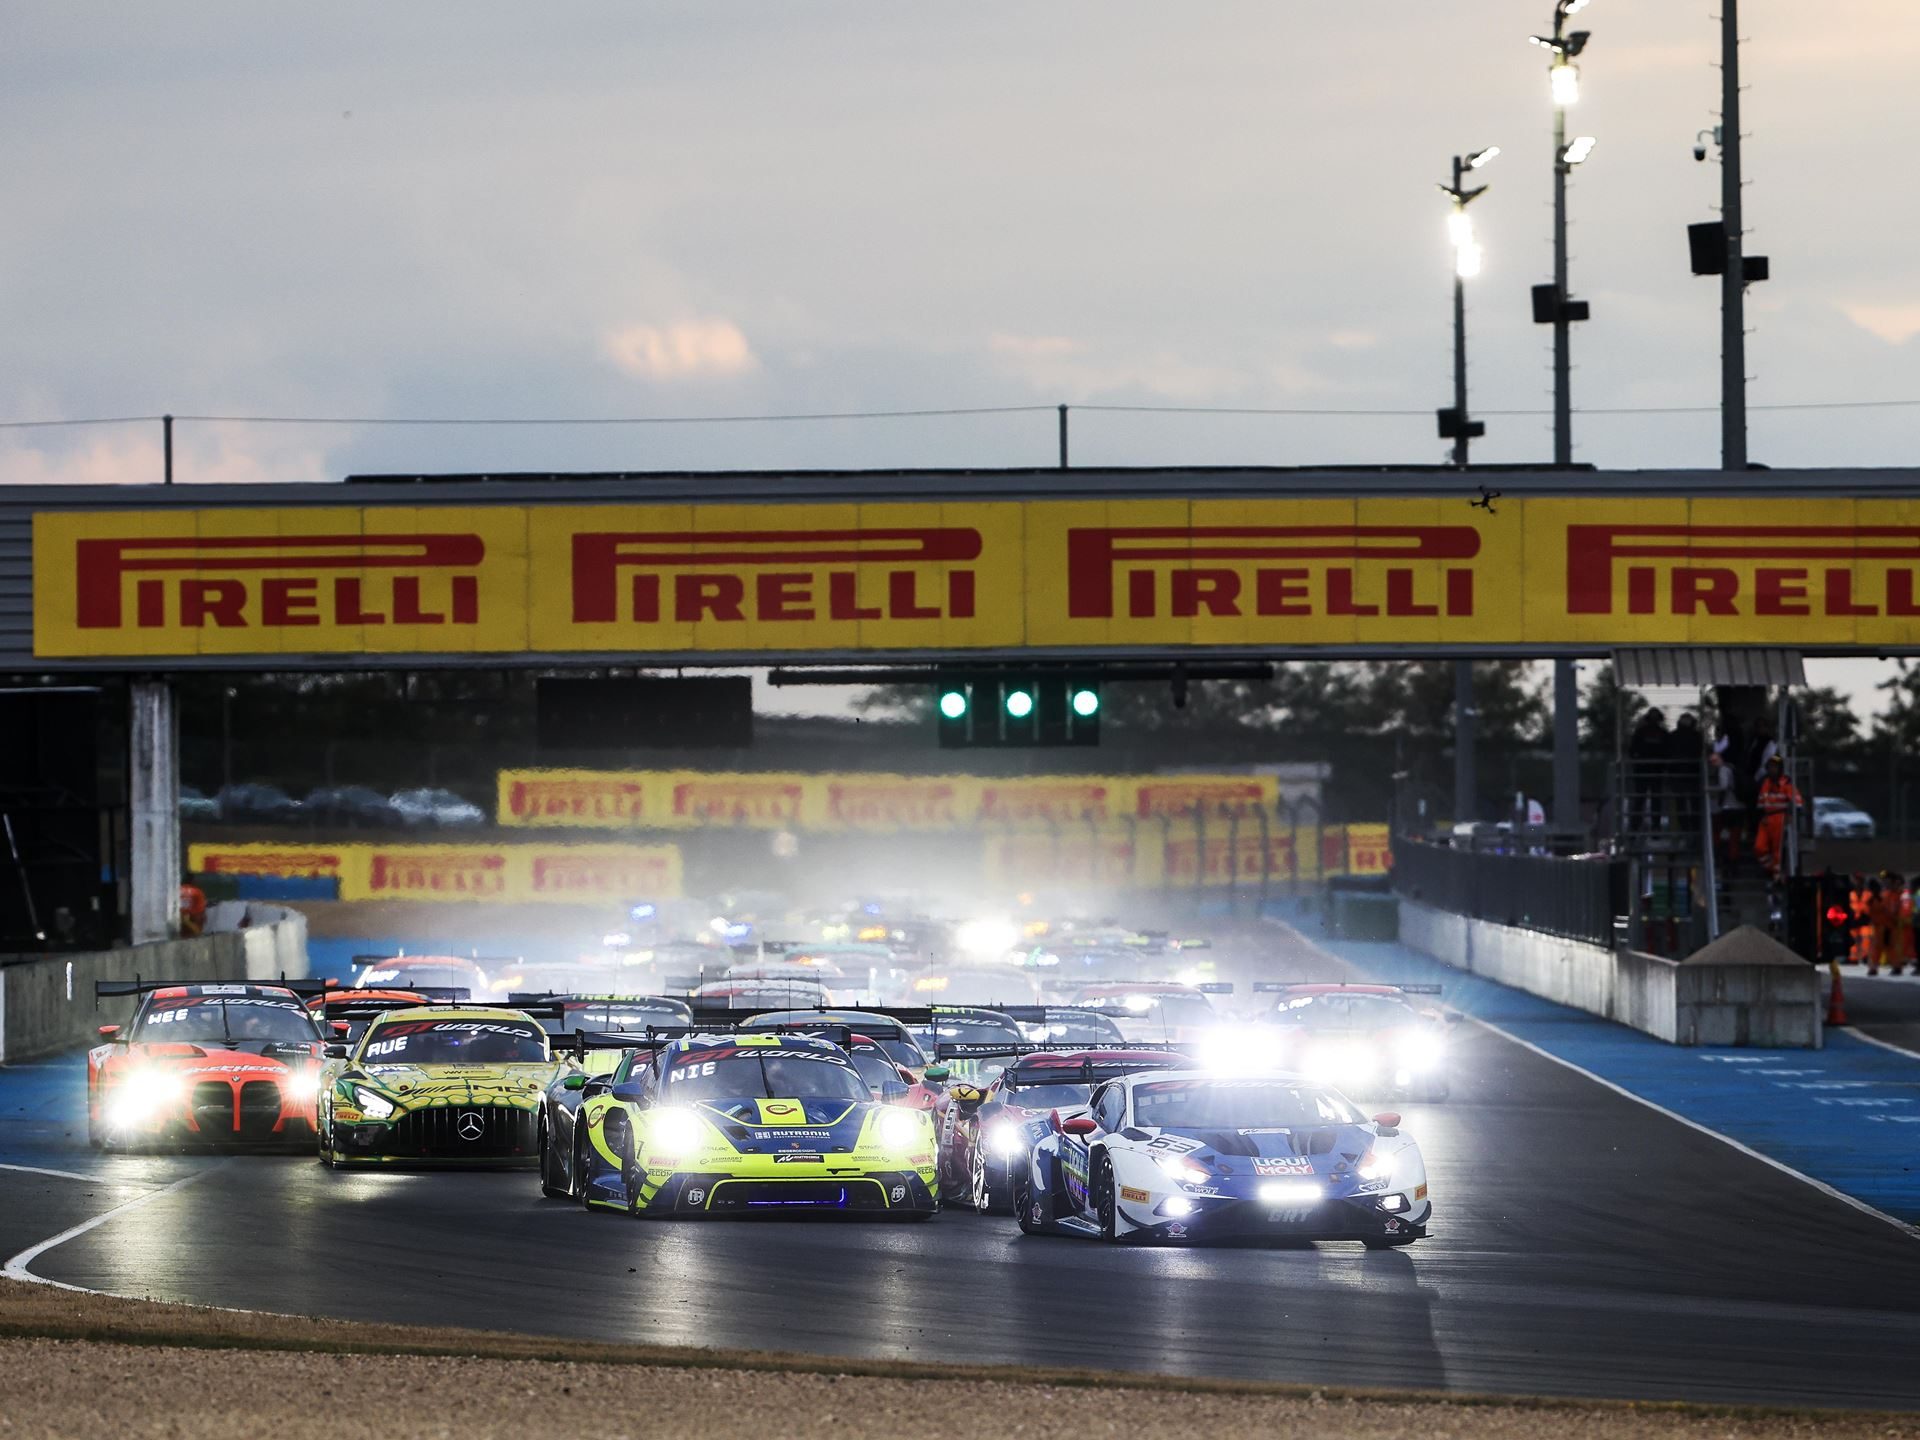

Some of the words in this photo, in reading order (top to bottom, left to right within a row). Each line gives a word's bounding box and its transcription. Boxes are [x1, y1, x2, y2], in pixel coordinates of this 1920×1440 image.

[571, 527, 983, 623] PIRELLI
[1068, 525, 1481, 618] PIRELLI
[76, 533, 485, 629] PIRELLI
[202, 998, 299, 1010] WORLD
[381, 1021, 450, 1037] GT
[433, 1023, 533, 1038] WORLD
[676, 1047, 751, 1064] GT
[735, 1049, 848, 1067] WORLD
[670, 1061, 717, 1083] NIE
[1147, 1137, 1197, 1154] 63
[1254, 1157, 1308, 1167] LIQUI
[1258, 1165, 1310, 1175] MOLY
[917, 1167, 934, 1175] RECO
[1121, 1188, 1147, 1201] PIRELLI
